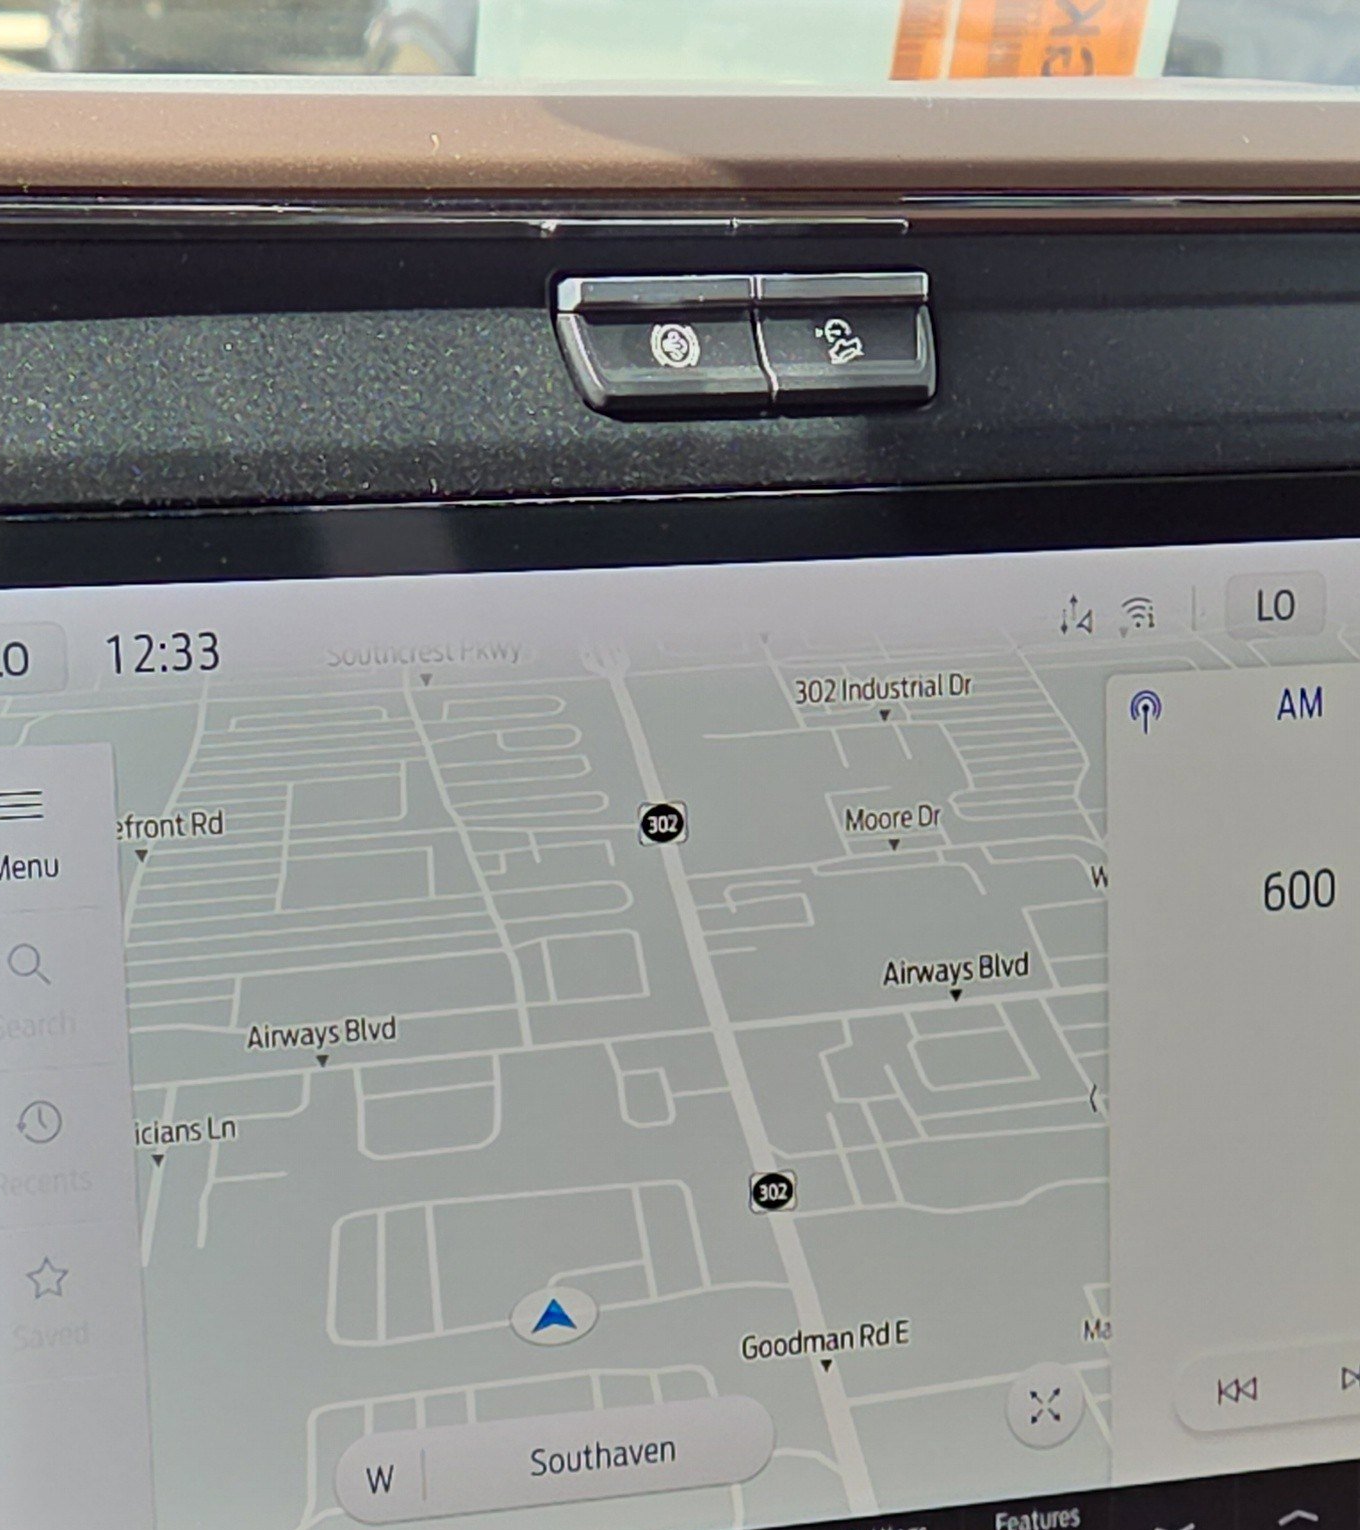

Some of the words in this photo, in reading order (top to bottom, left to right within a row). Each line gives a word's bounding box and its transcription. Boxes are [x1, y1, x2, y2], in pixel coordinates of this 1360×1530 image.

[1257, 588, 1296, 622] LO
[106, 630, 221, 676] 12:33
[794, 677, 837, 705] 302
[841, 672, 944, 702] Industrial
[948, 672, 973, 698] Dr
[1276, 685, 1324, 721] AM
[191, 810, 224, 837] Rd
[647, 813, 679, 836] 302
[845, 805, 912, 832] Moore
[917, 803, 941, 828] Dr
[1263, 866, 1337, 911] 600
[882, 953, 974, 987] Airways
[978, 951, 1029, 980] Blvd
[246, 1019, 339, 1051] Airways
[343, 1015, 397, 1042] Blvd
[207, 1116, 237, 1141] Ln
[759, 1181, 789, 1203] 302
[740, 1328, 854, 1361] Goodman
[858, 1321, 891, 1349] Rd
[895, 1319, 910, 1345] E
[366, 1464, 394, 1495] W
[530, 1437, 677, 1478] Southaven
